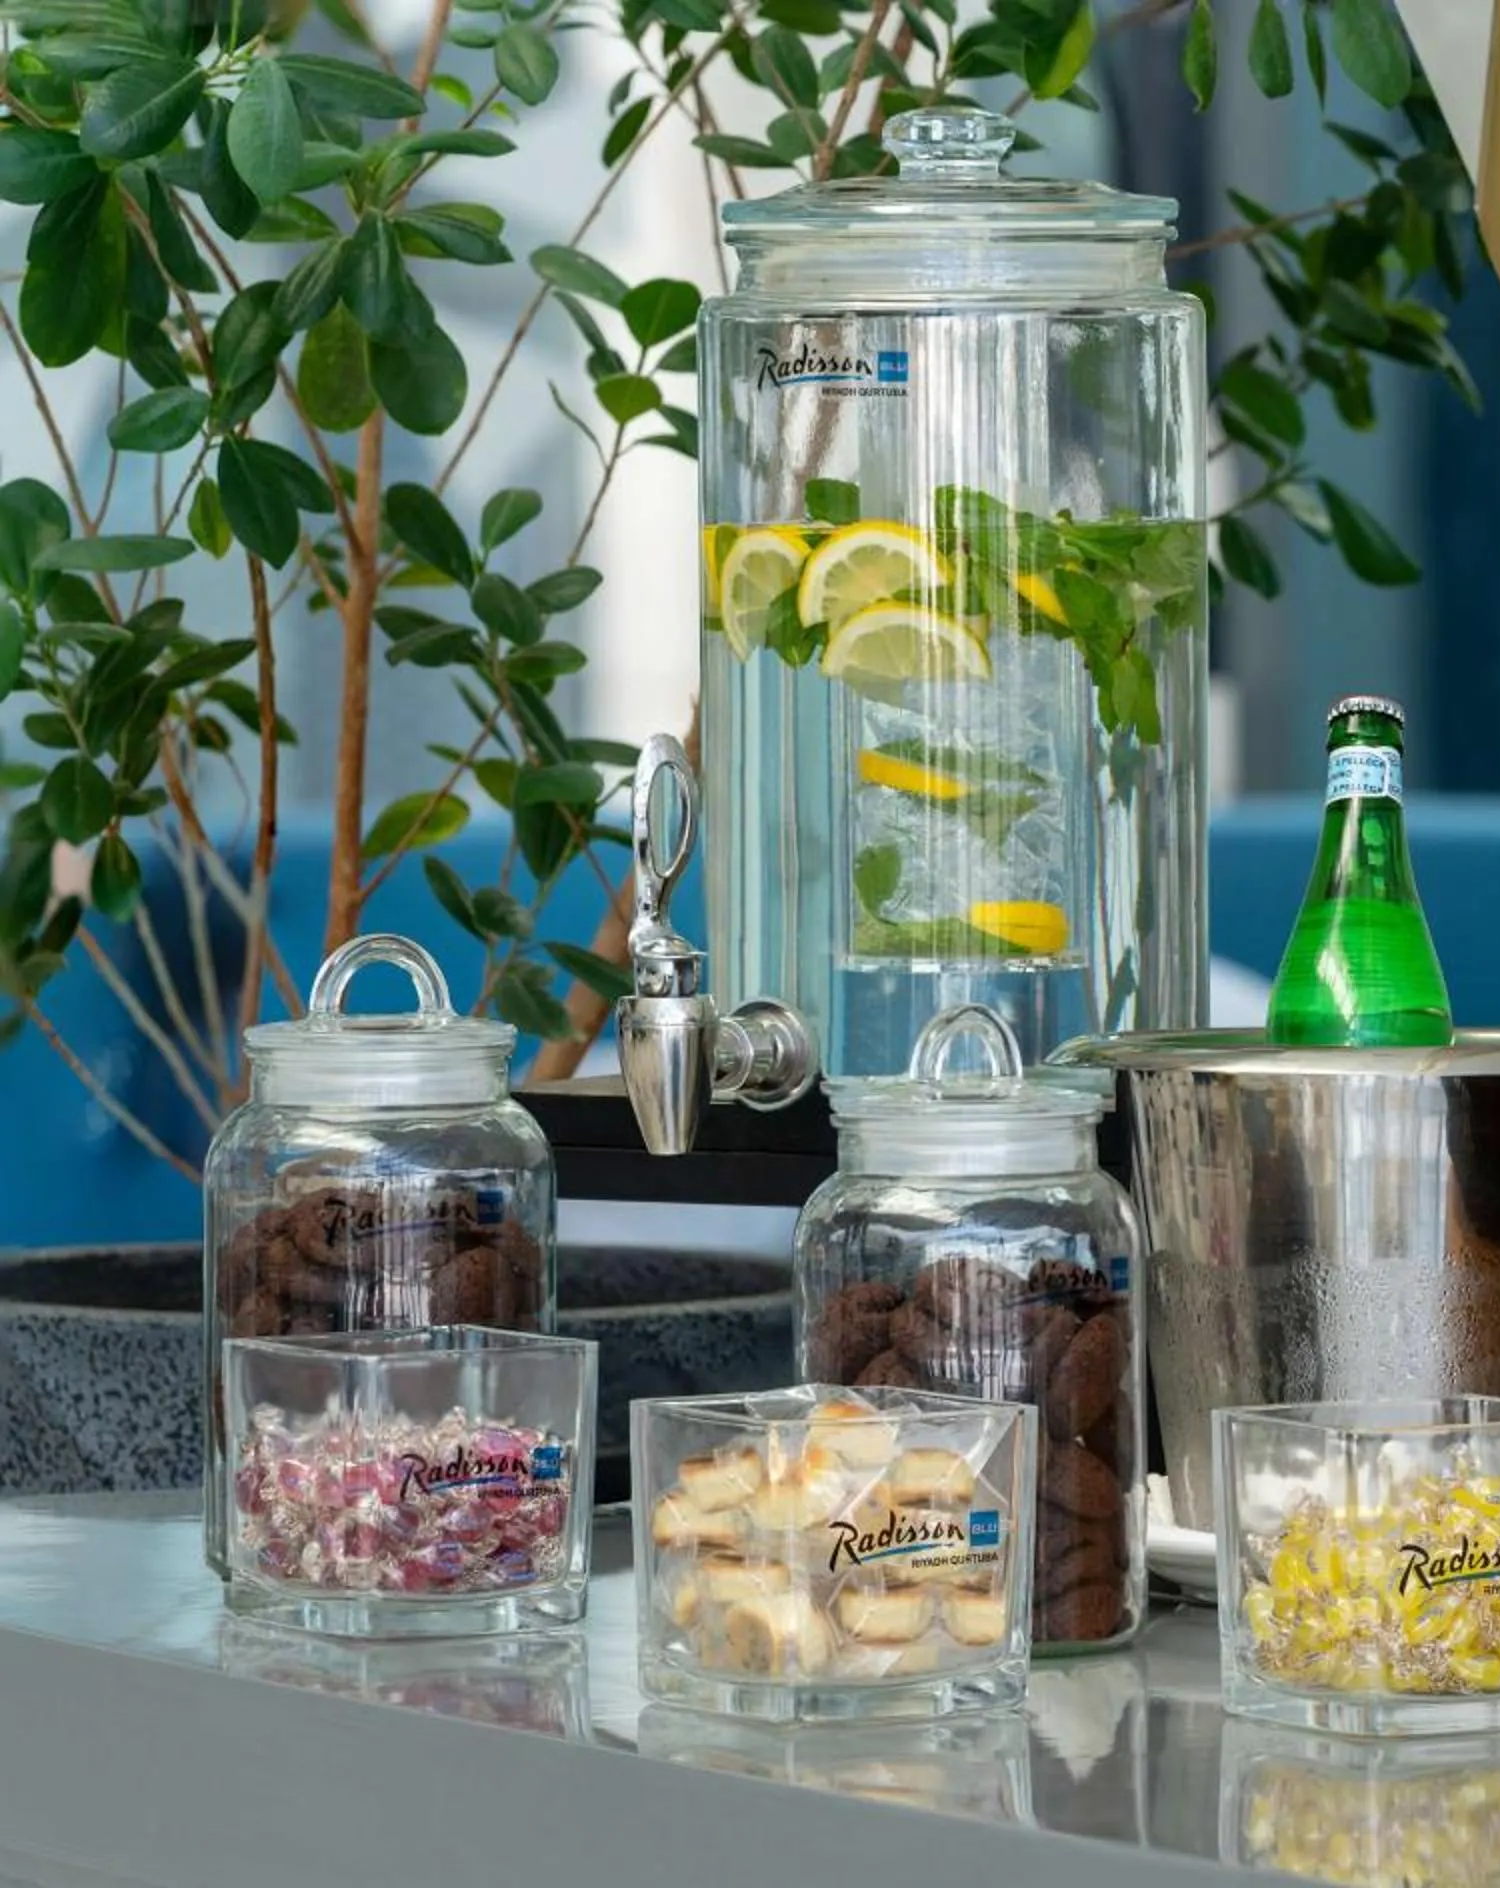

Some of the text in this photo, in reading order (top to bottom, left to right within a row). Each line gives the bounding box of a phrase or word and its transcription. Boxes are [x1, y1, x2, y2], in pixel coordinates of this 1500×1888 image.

[757, 343, 872, 392] Radisson
[400, 1445, 529, 1500] Radisson
[828, 1509, 964, 1573] Radisson
